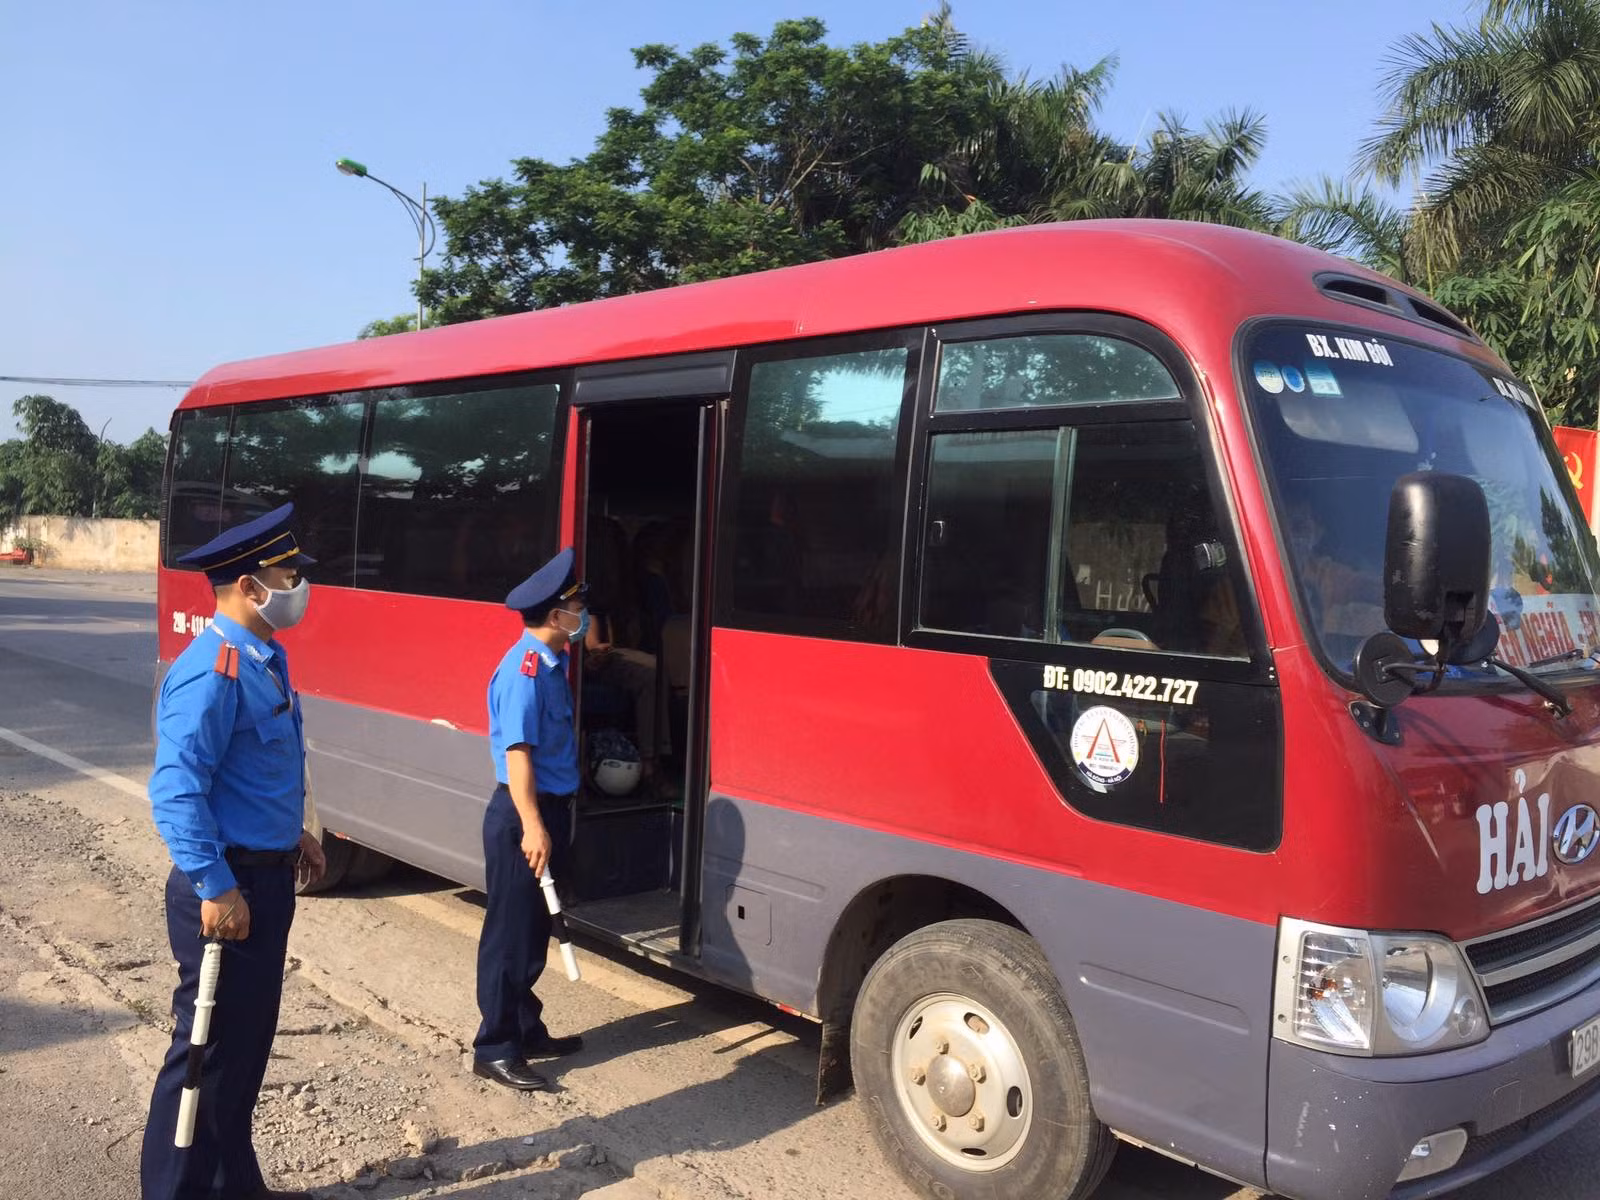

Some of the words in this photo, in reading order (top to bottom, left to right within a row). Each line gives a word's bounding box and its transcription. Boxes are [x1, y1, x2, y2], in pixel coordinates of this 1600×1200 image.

[1305, 333, 1340, 359] BX.
[1334, 336, 1370, 362] KIM
[1364, 338, 1394, 367] BÔI
[1043, 665, 1069, 690] ĐT:
[1072, 668, 1199, 705] 0902.422.727
[1475, 768, 1550, 895] HẢI
